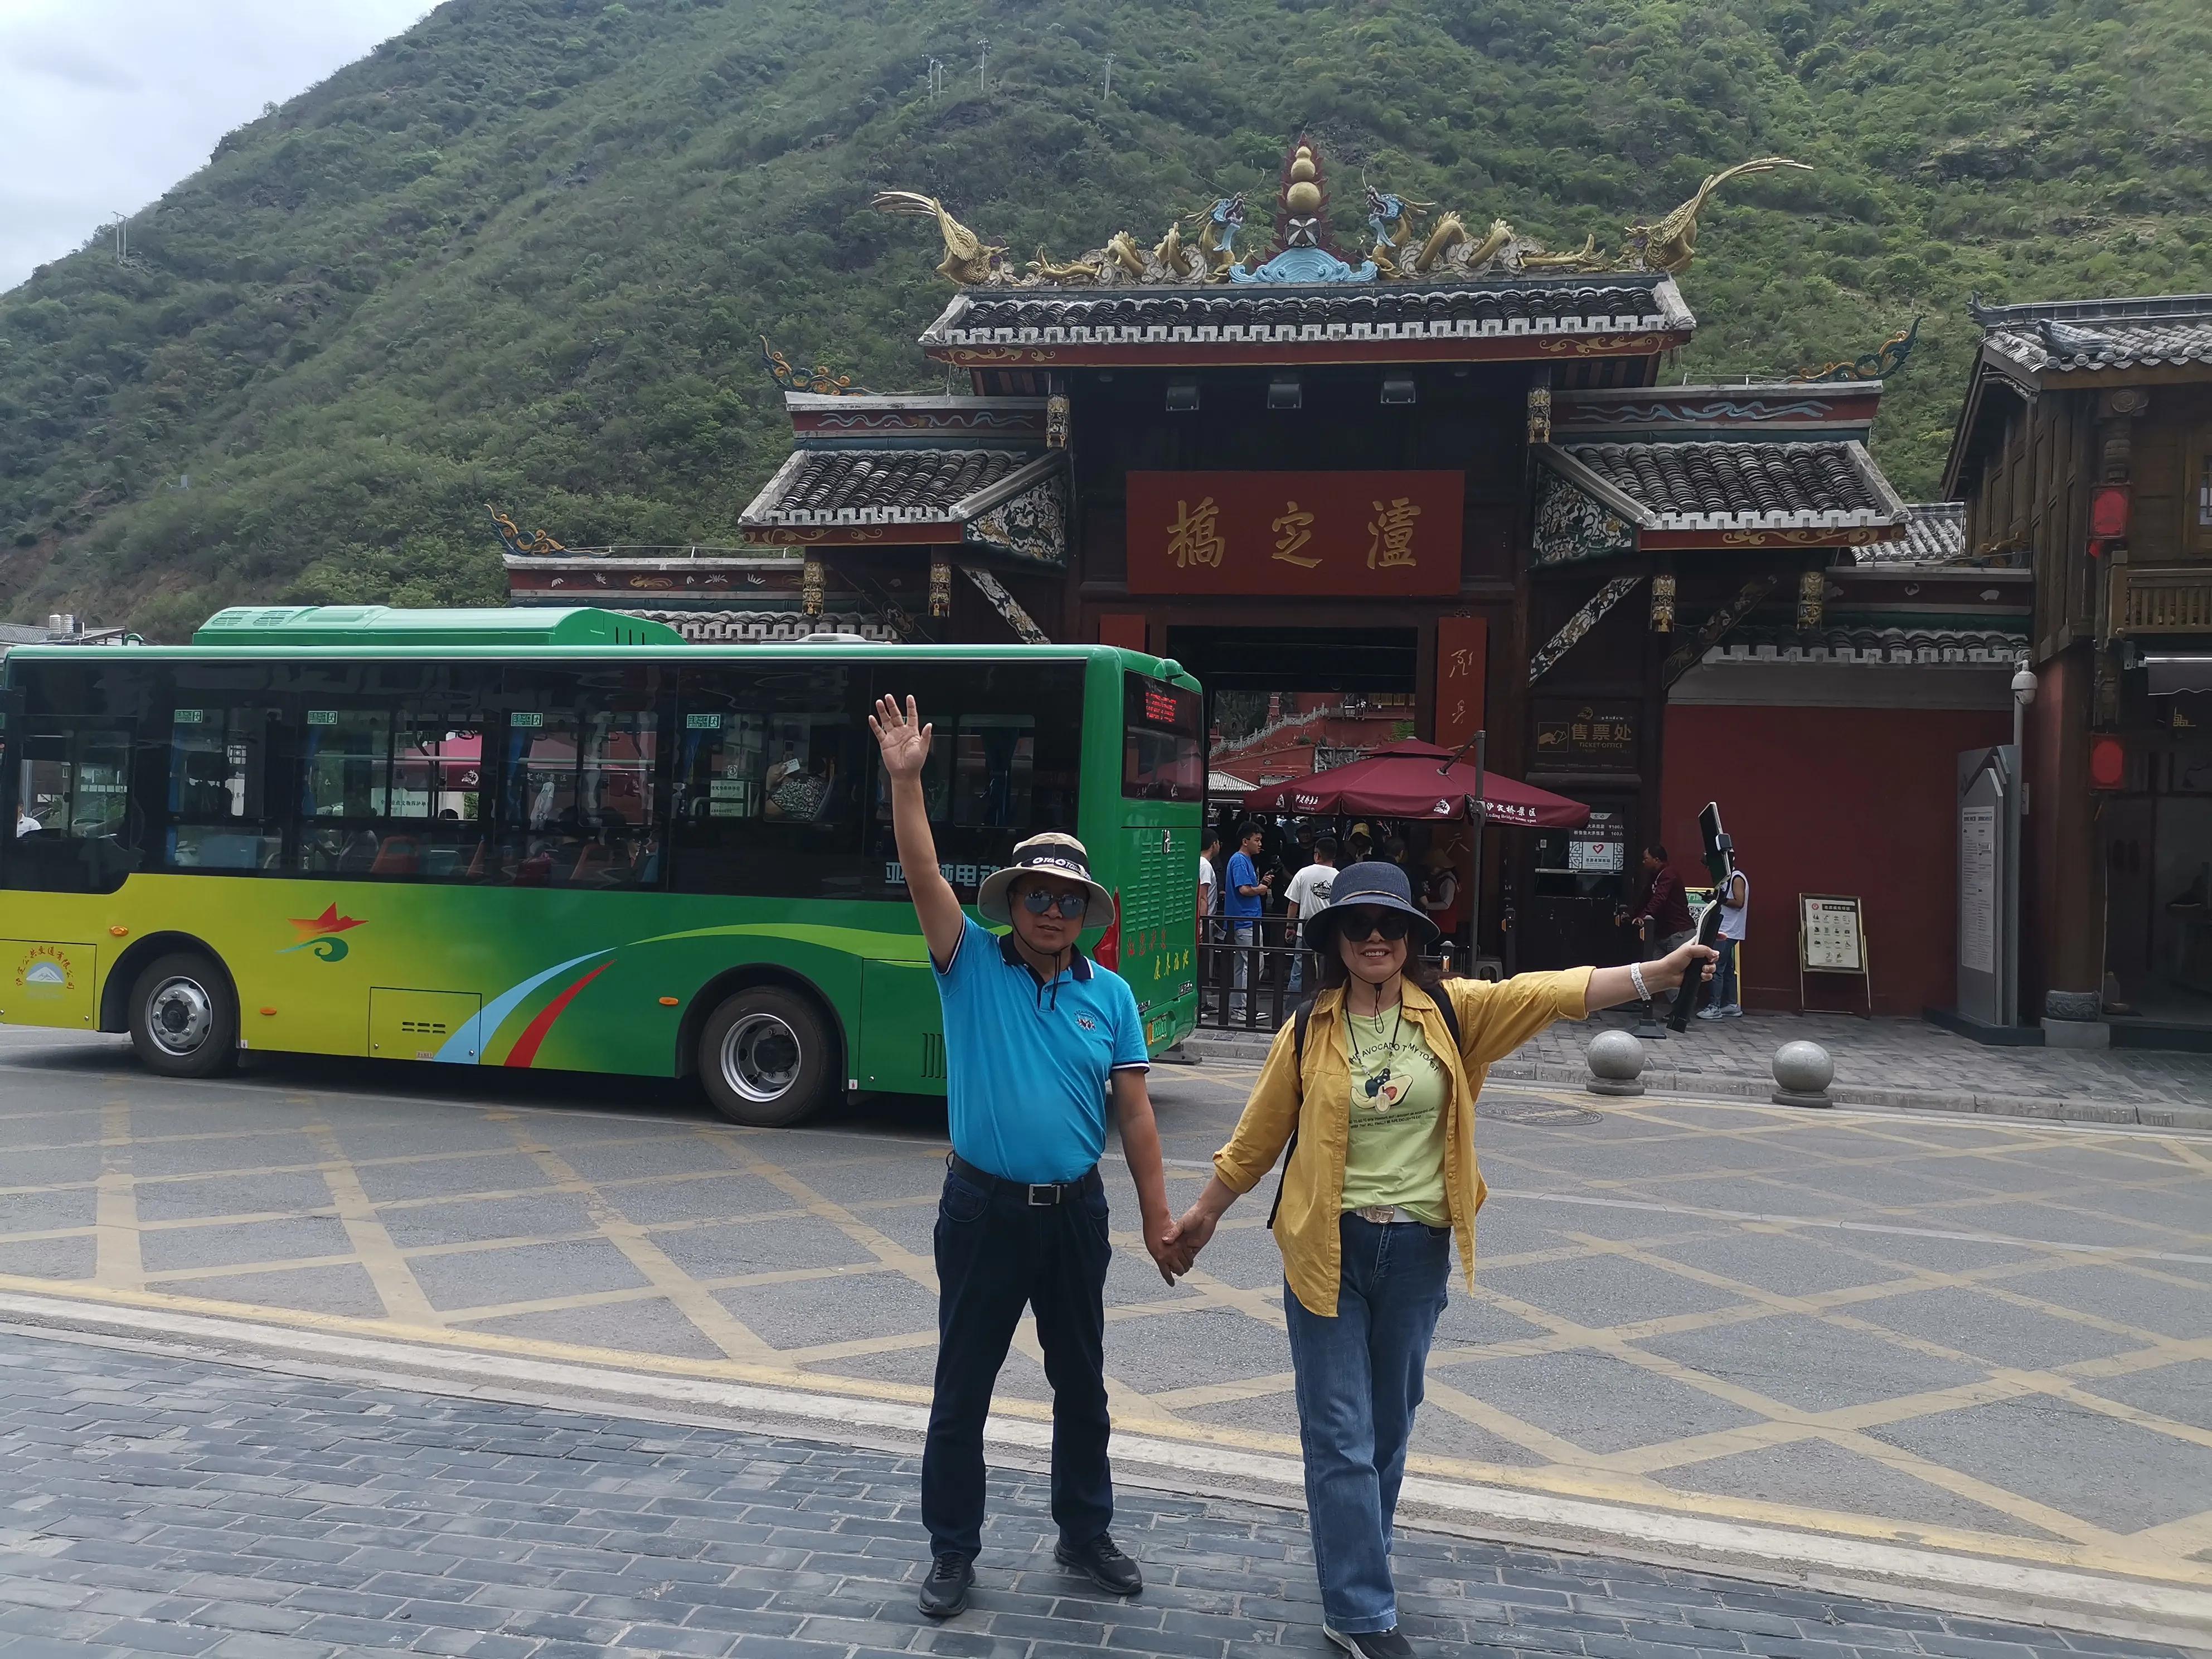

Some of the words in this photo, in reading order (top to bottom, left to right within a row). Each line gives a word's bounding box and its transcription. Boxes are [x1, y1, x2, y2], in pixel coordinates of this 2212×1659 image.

[1571, 723, 1632, 741] 售票处
[1408, 1043, 1419, 1054] MY
